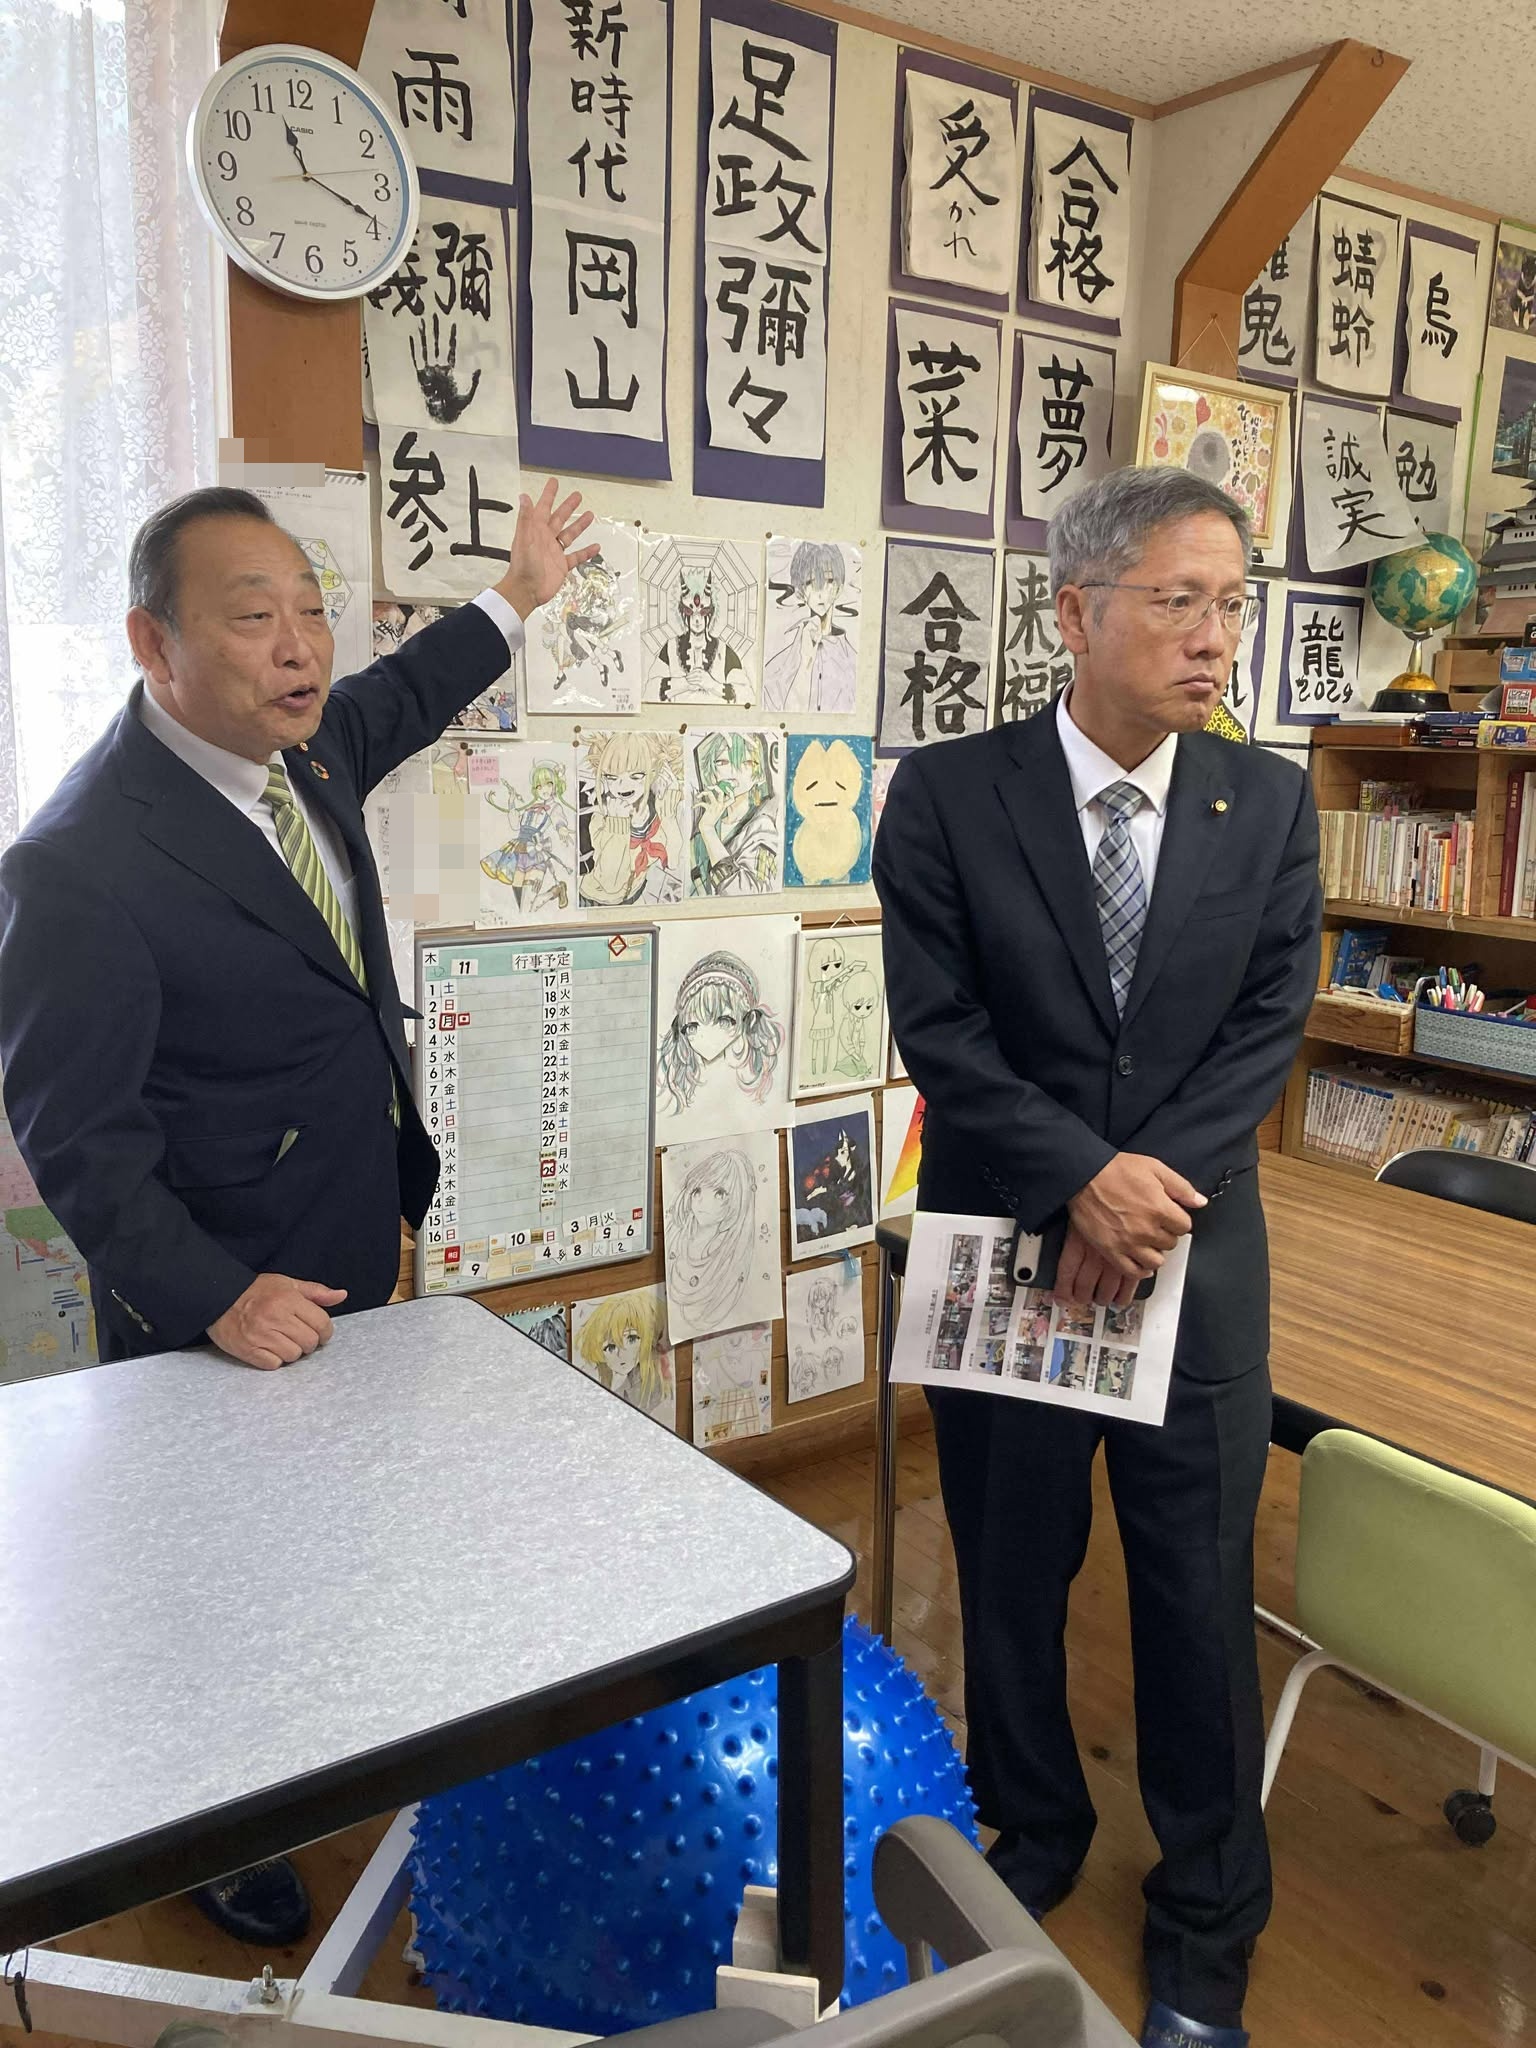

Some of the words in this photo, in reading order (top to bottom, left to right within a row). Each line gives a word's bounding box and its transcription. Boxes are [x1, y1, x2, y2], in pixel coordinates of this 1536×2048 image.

[392, 0, 472, 141] 雨
[251, 82, 276, 114] 11
[286, 78, 314, 111] 12
[560, 0, 634, 203] 新時代
[331, 96, 343, 125] 1
[223, 108, 252, 141] 10
[290, 126, 314, 135] CASIO
[359, 129, 375, 159] 2
[217, 150, 238, 181] 9
[374, 173, 391, 202] 3
[235, 196, 255, 226] 8
[1044, 136, 1119, 303] 合格
[365, 214, 382, 241] 4
[269, 231, 286, 259] 7
[305, 245, 324, 274] 6
[343, 239, 358, 267] 5
[1329, 226, 1377, 368] 蜻蛉
[563, 228, 641, 413] 岡山
[1037, 353, 1094, 494] 夢
[1323, 427, 1408, 551] 誠実
[1395, 440, 1438, 532] 勉
[386, 431, 514, 571] 参上
[1299, 610, 1345, 678] 龍
[899, 571, 986, 742] 合格
[1295, 676, 1354, 704] 2024
[425, 952, 436, 964] 木
[515, 952, 571, 970] 行事予定
[458, 960, 471, 975] 11
[544, 975, 556, 987] 17
[560, 972, 570, 984] 月
[429, 985, 435, 996] 1
[444, 982, 455, 994] 土
[545, 991, 557, 1003] 18
[560, 988, 570, 1000] 火
[429, 1001, 437, 1013] 2
[445, 999, 454, 1011] 日
[544, 1007, 556, 1019] 19
[559, 1006, 570, 1017] 水
[428, 1018, 436, 1030] 3
[443, 1016, 453, 1027] 月
[544, 1024, 557, 1035] 20
[559, 1022, 570, 1033] 木
[429, 1035, 437, 1046] 4
[444, 1034, 455, 1046] 火
[543, 1040, 555, 1051] 21
[559, 1039, 569, 1050] 金
[429, 1051, 437, 1063] 5
[444, 1051, 455, 1062] 水
[543, 1056, 557, 1067] 22
[559, 1055, 569, 1066] 土
[430, 1067, 438, 1079] 6
[445, 1067, 456, 1078] 木
[543, 1071, 557, 1082] 23
[559, 1070, 570, 1082] 水
[429, 1085, 437, 1097] 7
[444, 1083, 455, 1095] 金
[542, 1086, 557, 1098] 24
[558, 1086, 569, 1097] 木
[431, 1102, 438, 1113] 8
[446, 1100, 456, 1111] 土
[542, 1102, 556, 1114] 25
[558, 1101, 569, 1112] 金
[430, 1117, 438, 1128] 9
[445, 1115, 455, 1127] 日
[542, 1119, 556, 1131] 26
[558, 1117, 568, 1128] 土
[445, 1131, 455, 1144] 月
[542, 1135, 556, 1147] 27
[559, 1131, 568, 1142] 日
[445, 1147, 456, 1159] 火
[558, 1147, 568, 1159] 月
[445, 1163, 456, 1175] 水
[559, 1162, 569, 1174] 火
[445, 1179, 456, 1190] 木
[559, 1178, 568, 1190] 水
[445, 1195, 456, 1207] 金
[428, 1215, 441, 1227] 15
[446, 1211, 457, 1223] 土
[590, 1215, 598, 1227] 月
[604, 1211, 615, 1224] 火
[571, 1220, 579, 1233] 3
[428, 1231, 441, 1243] 16
[446, 1228, 455, 1241] 日
[511, 1232, 525, 1247] 10
[546, 1231, 555, 1241] 日
[543, 1246, 551, 1258] 4
[573, 1244, 582, 1256] 8
